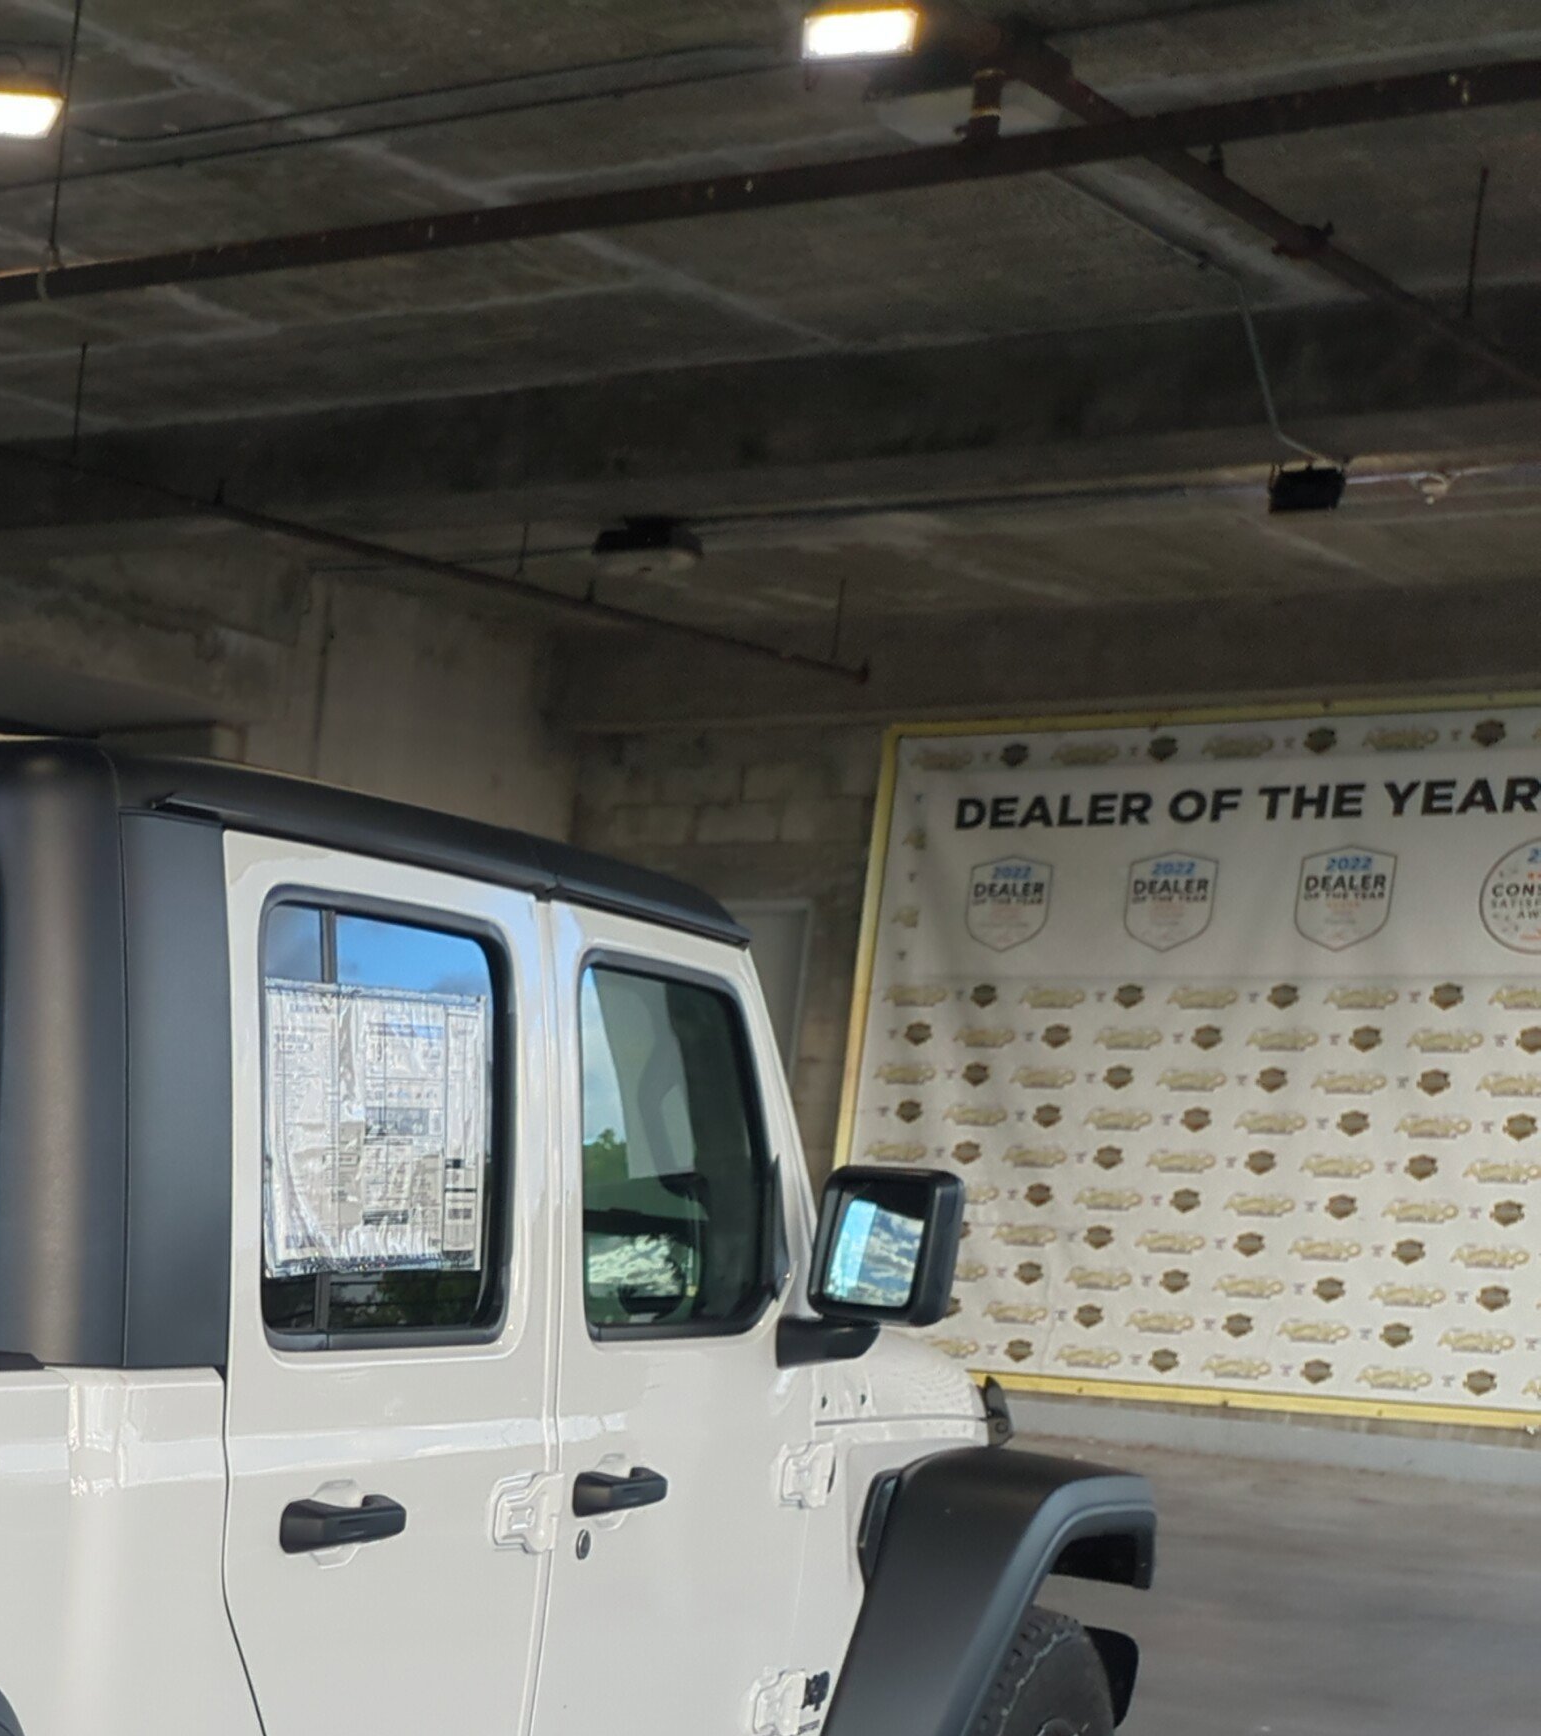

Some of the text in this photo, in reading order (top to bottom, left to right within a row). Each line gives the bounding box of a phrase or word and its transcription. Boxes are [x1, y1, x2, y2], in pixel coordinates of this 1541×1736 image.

[955, 776, 1541, 831] DEALER OF THE YEAR
[974, 881, 1044, 898] DEALER
[1133, 878, 1209, 895] DEALER
[1304, 874, 1386, 892] DEALER
